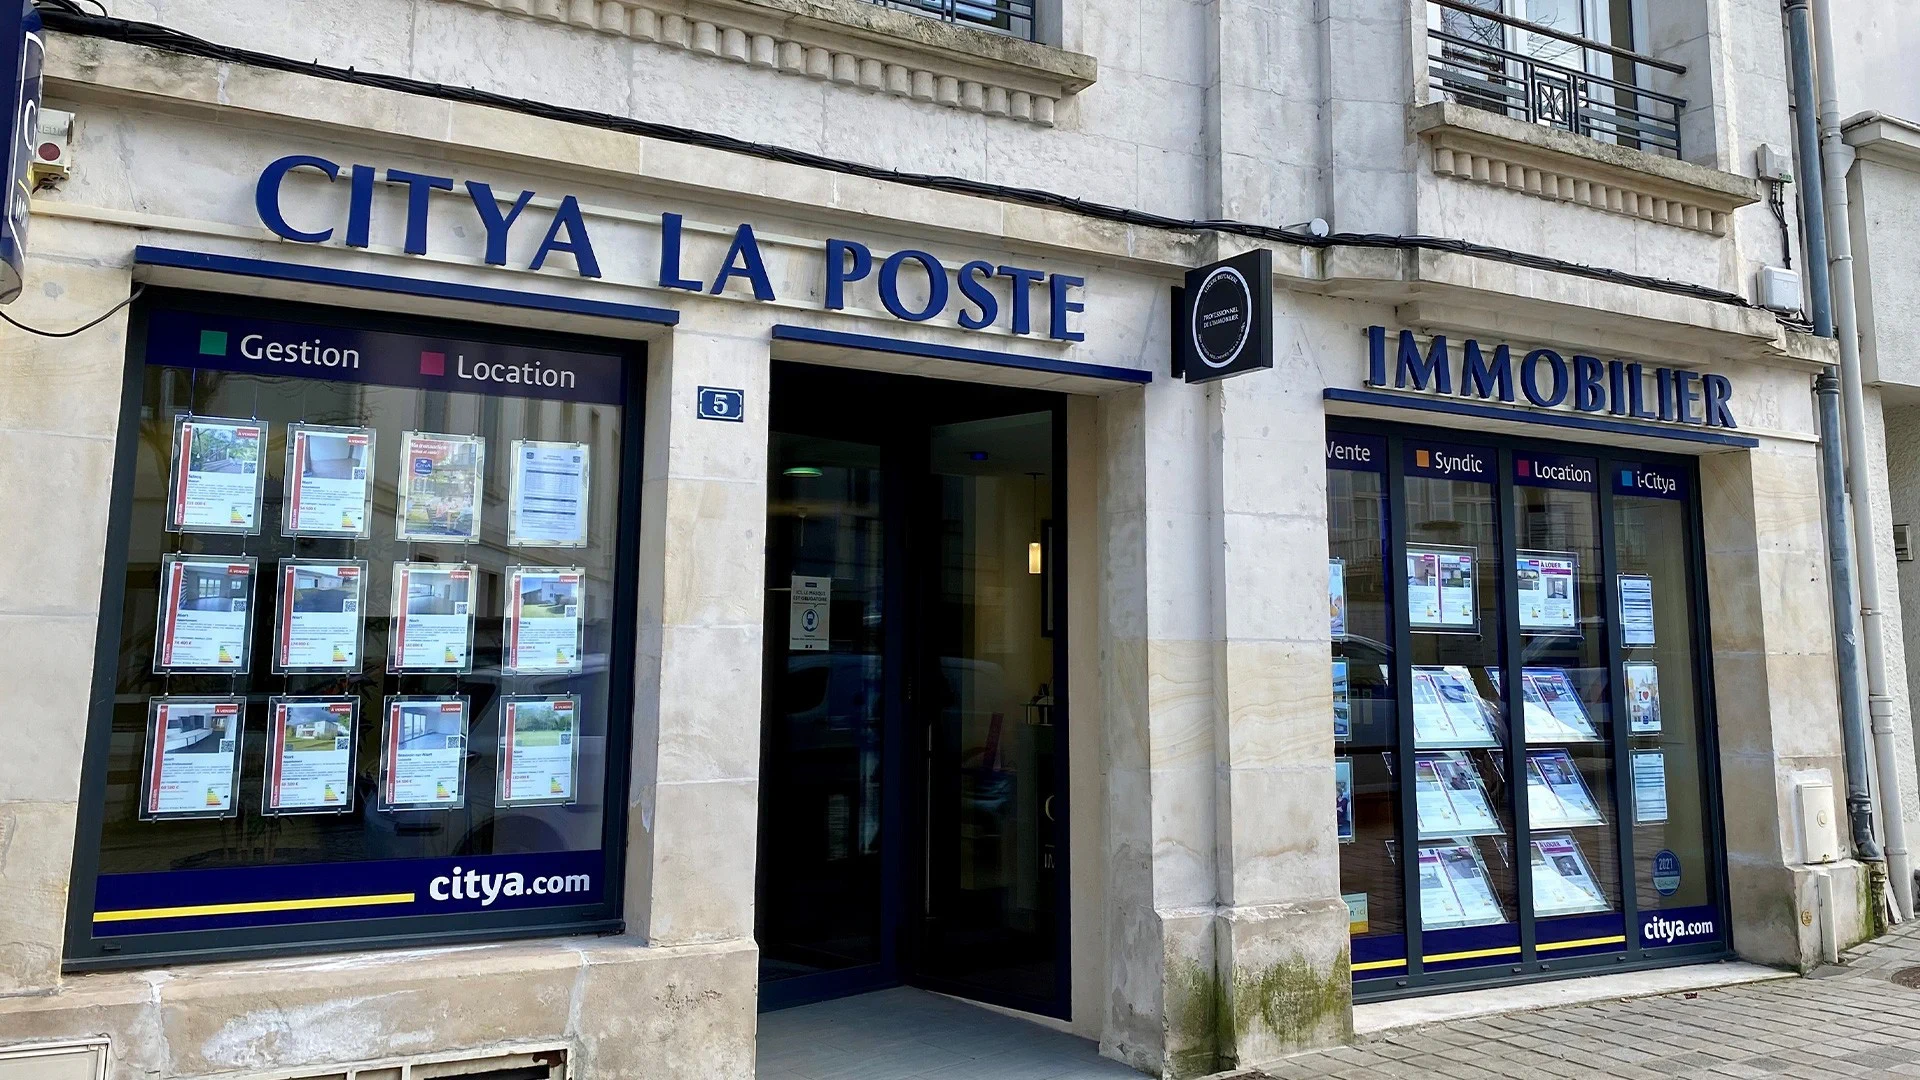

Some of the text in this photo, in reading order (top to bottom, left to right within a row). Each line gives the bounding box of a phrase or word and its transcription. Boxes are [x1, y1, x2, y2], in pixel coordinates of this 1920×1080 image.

[255, 154, 1085, 343] CITYA LA POSTE
[240, 334, 360, 369] Gestion
[457, 355, 576, 389] Location
[1368, 324, 1738, 429] IMMOBILIER
[713, 394, 728, 415] 5
[1326, 441, 1371, 462] Vente
[1435, 452, 1483, 474] Syndic
[1534, 461, 1592, 483] Location
[1637, 471, 1676, 494] i-Citya
[1658, 858, 1673, 870] 2021
[428, 866, 591, 906] citya.com
[1644, 916, 1714, 943] citya.com
